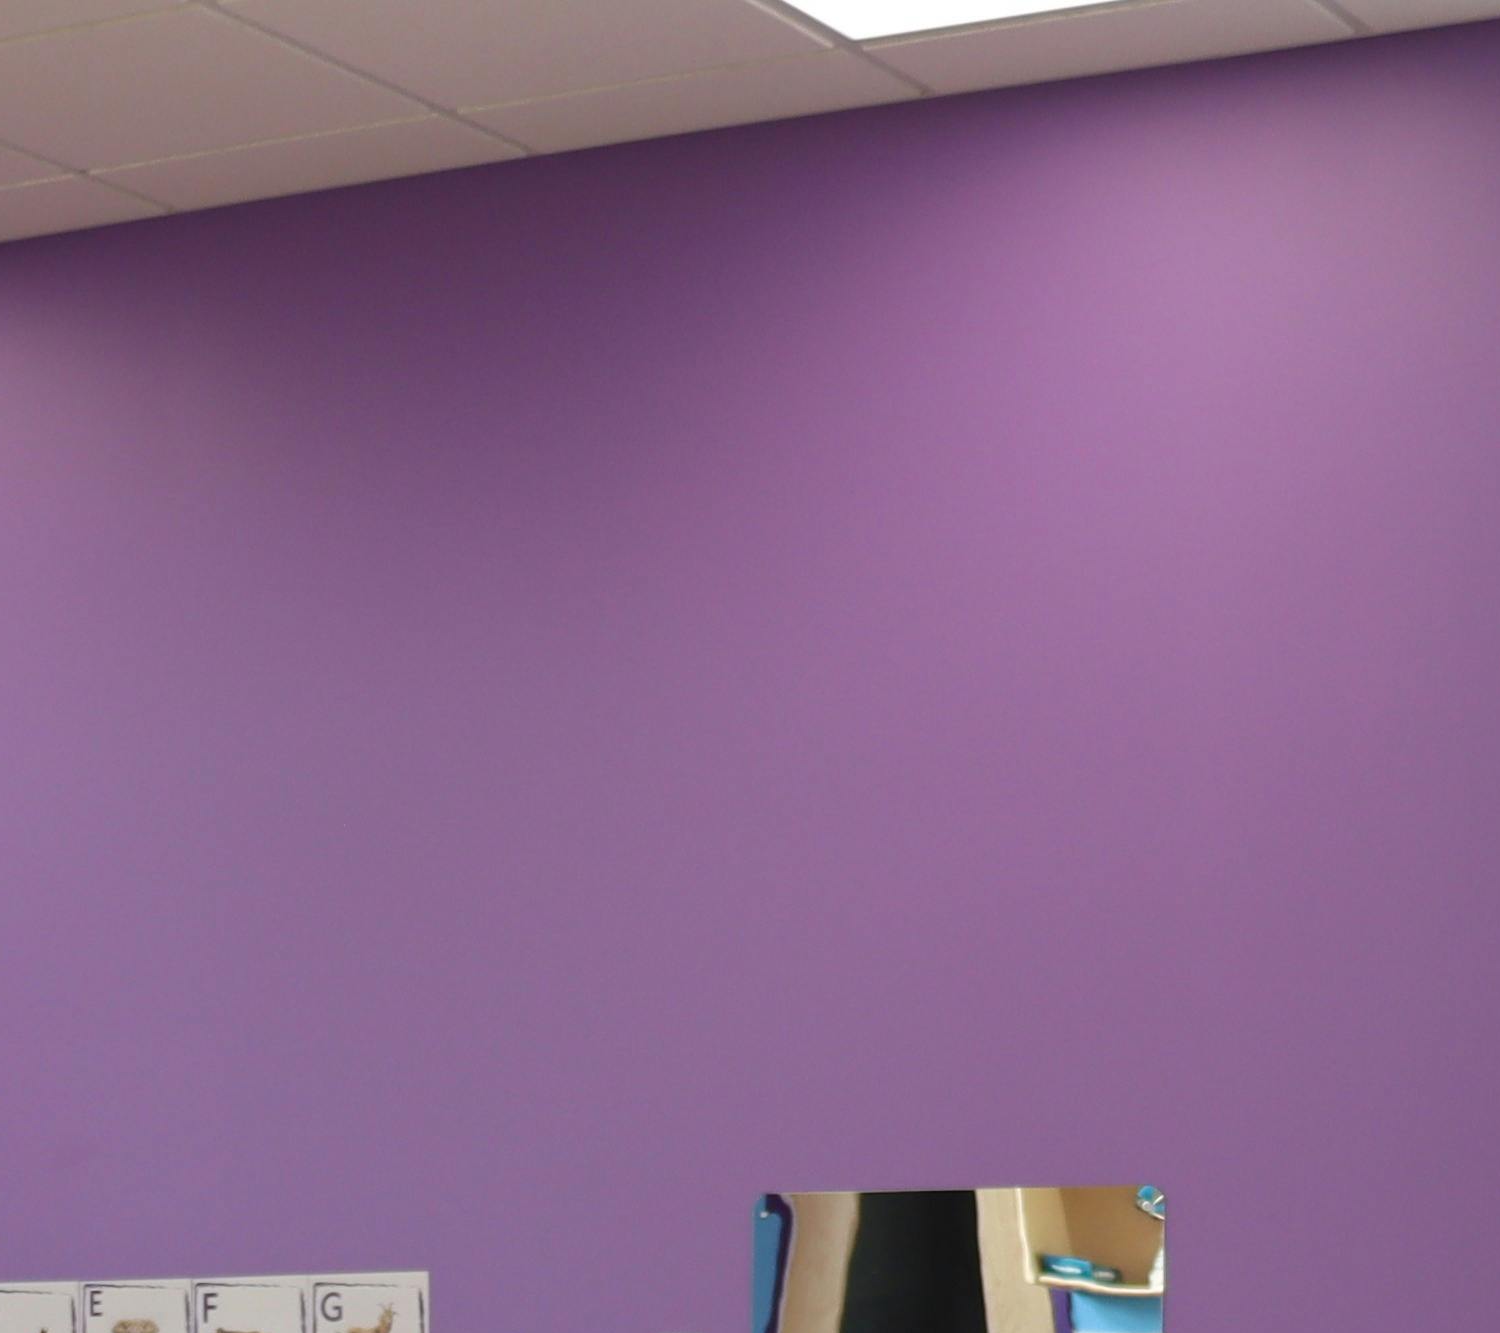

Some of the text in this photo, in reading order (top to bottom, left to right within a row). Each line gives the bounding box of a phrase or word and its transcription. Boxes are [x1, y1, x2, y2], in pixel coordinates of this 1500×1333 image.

[90, 1290, 102, 1317] E
[203, 1293, 218, 1323] F
[321, 1292, 342, 1322] G
